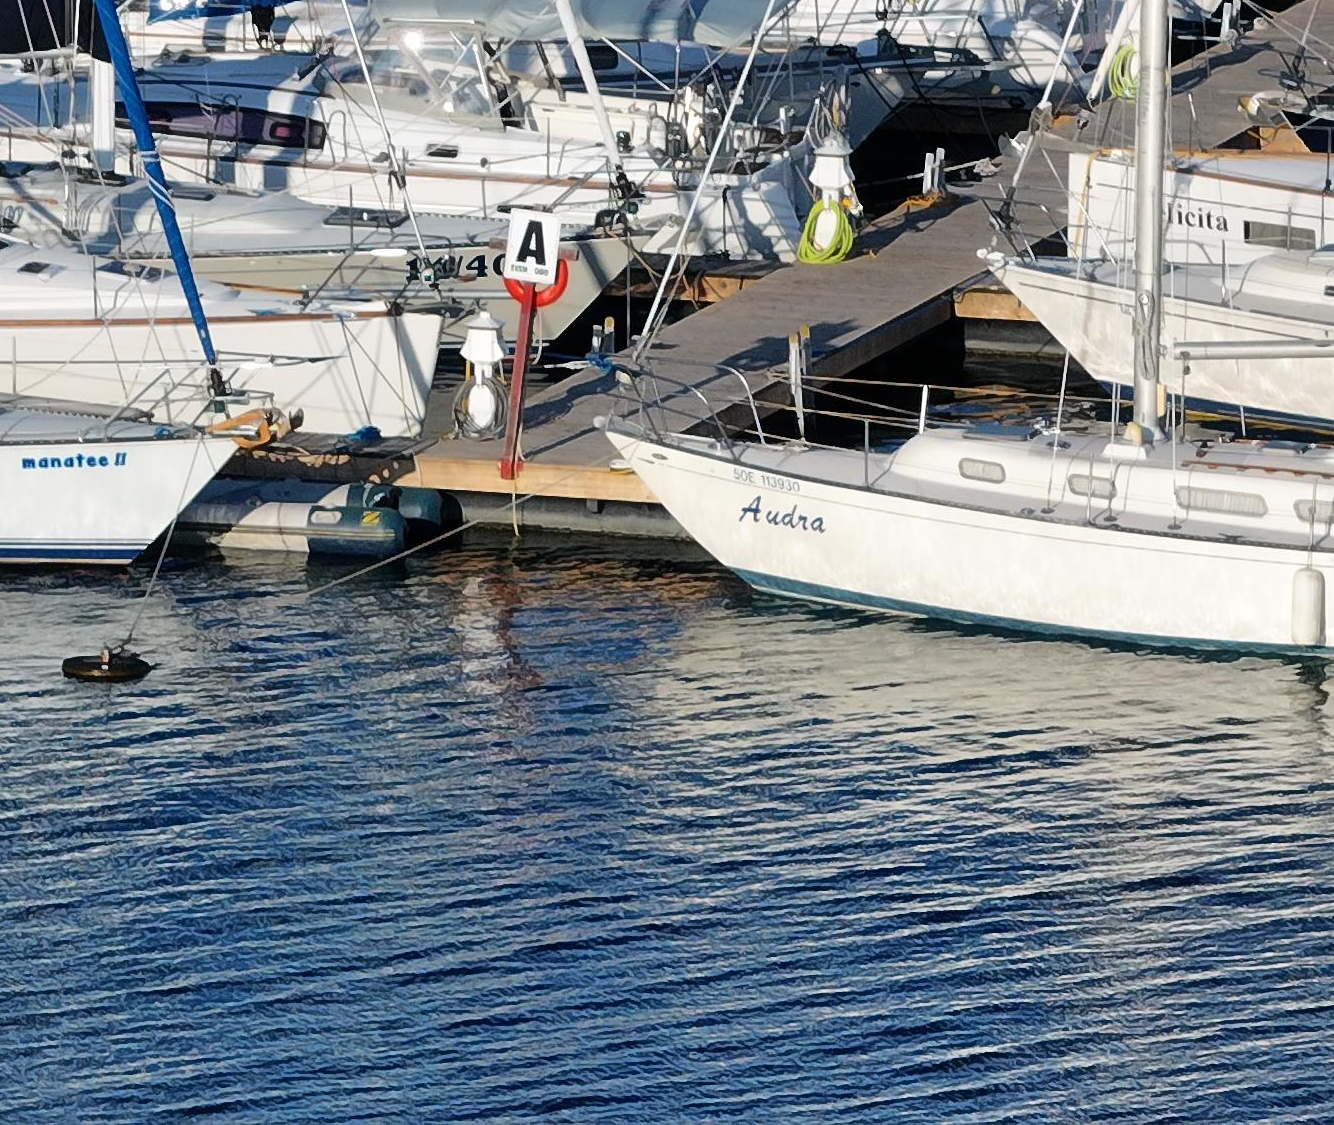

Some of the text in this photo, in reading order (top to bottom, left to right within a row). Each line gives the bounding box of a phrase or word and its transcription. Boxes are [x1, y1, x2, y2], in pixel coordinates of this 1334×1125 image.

[1163, 202, 1229, 232] licita
[516, 219, 547, 266] A
[22, 454, 109, 469] manatee
[738, 494, 827, 534] Audra
